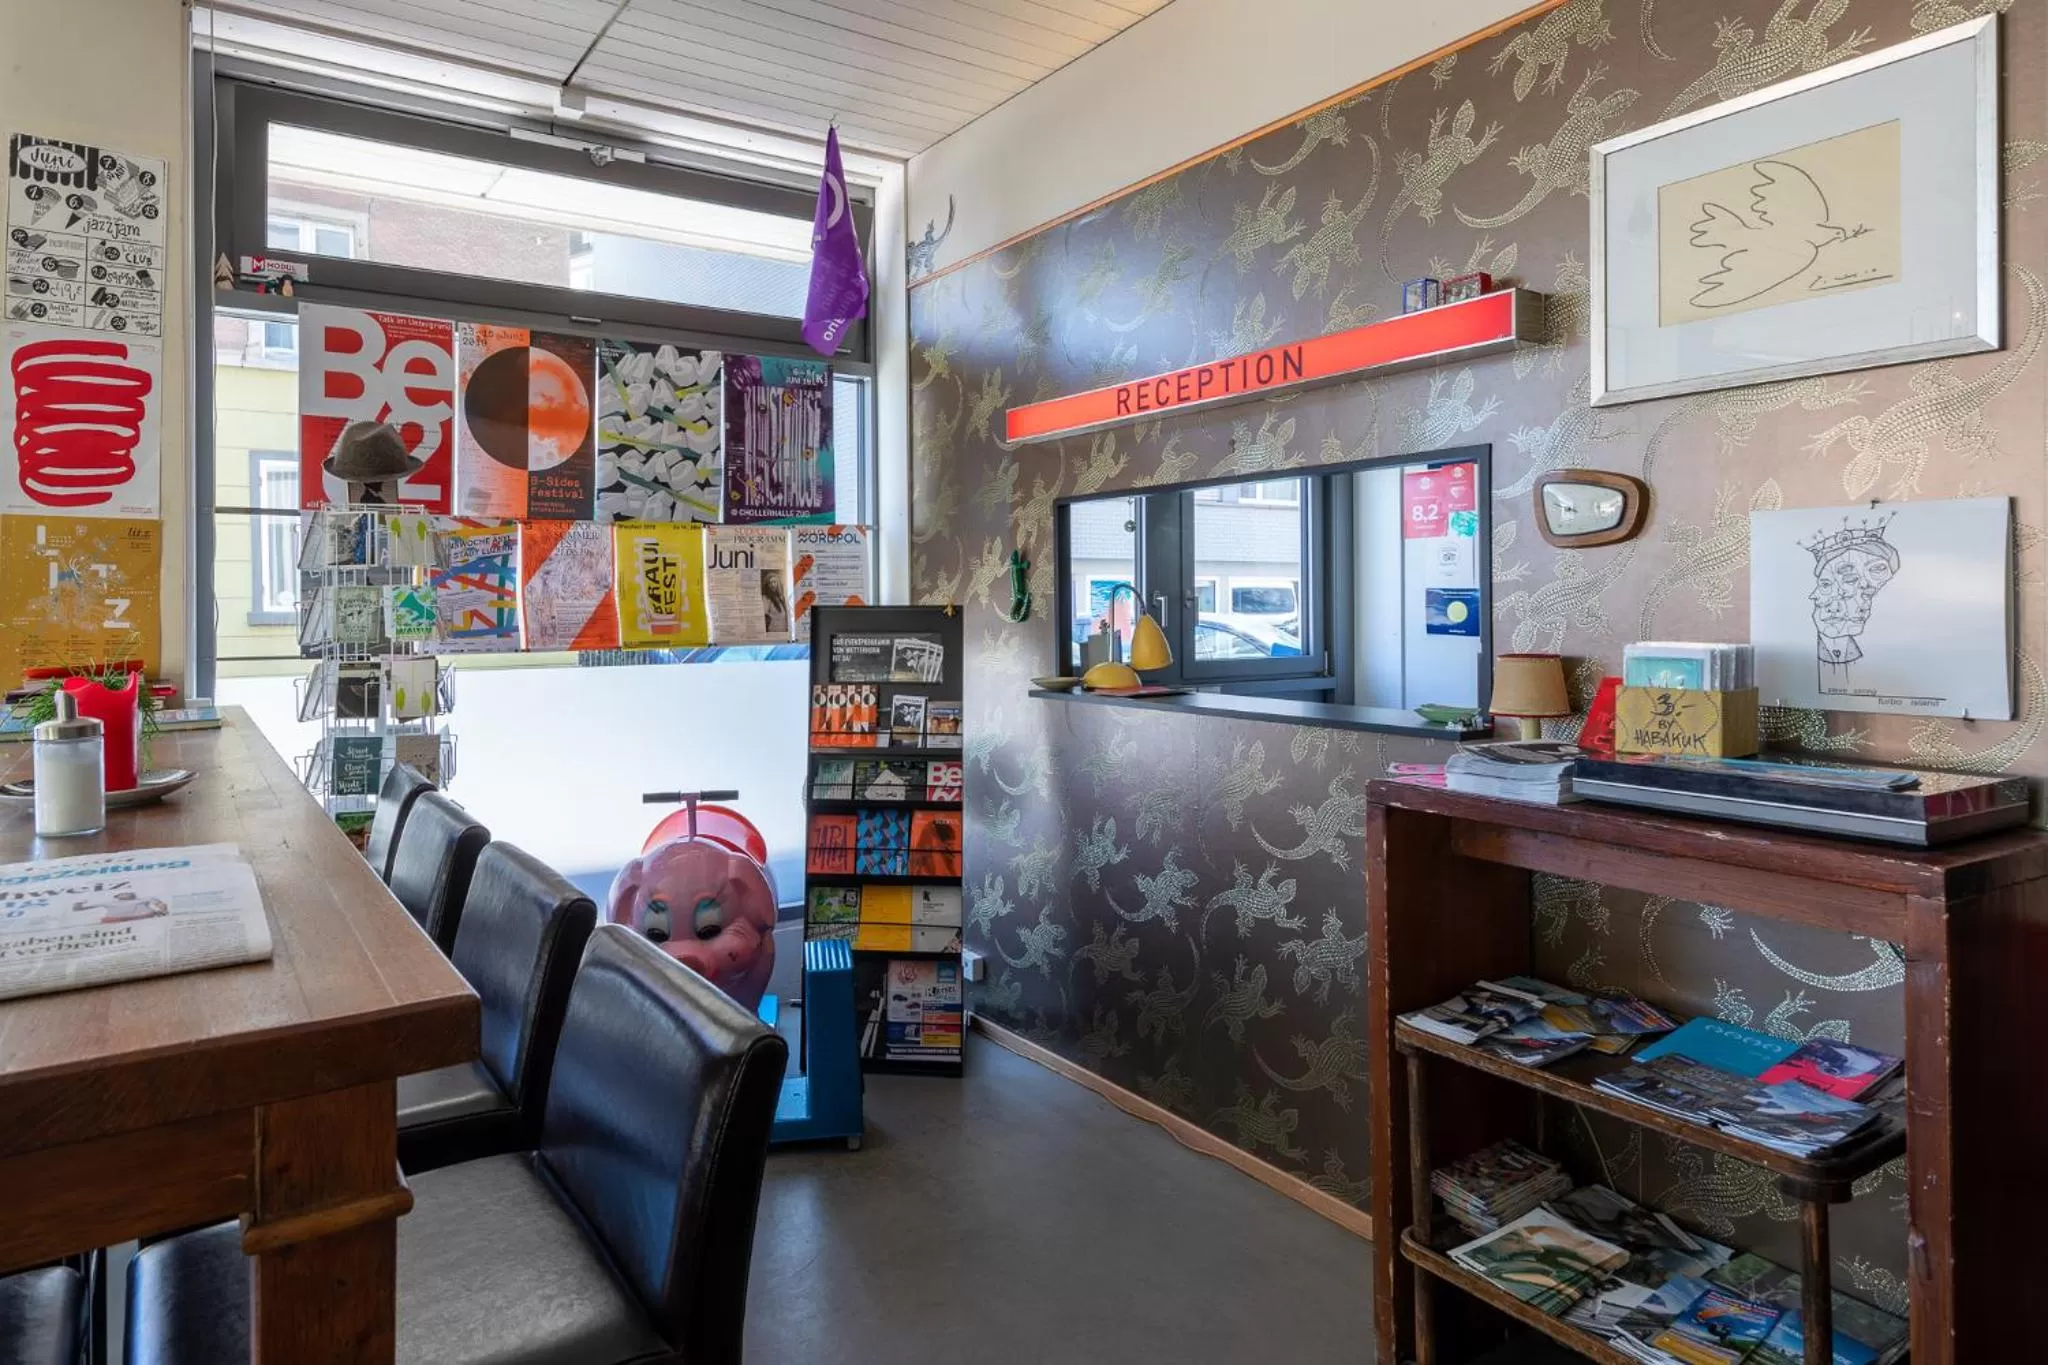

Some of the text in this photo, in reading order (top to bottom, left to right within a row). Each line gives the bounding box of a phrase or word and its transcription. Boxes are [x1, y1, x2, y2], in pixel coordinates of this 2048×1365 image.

[31, 148, 75, 169] Juni
[1117, 346, 1305, 416] RECEPTION
[530, 476, 581, 489] B-Sides
[530, 487, 585, 500] Festival
[734, 535, 787, 545] PROGRAMM
[709, 543, 755, 569] Juni
[662, 556, 678, 616] FEST
[1658, 719, 1676, 730] BY
[1633, 729, 1708, 750] HABAKUK
[80, 926, 133, 940] sind
